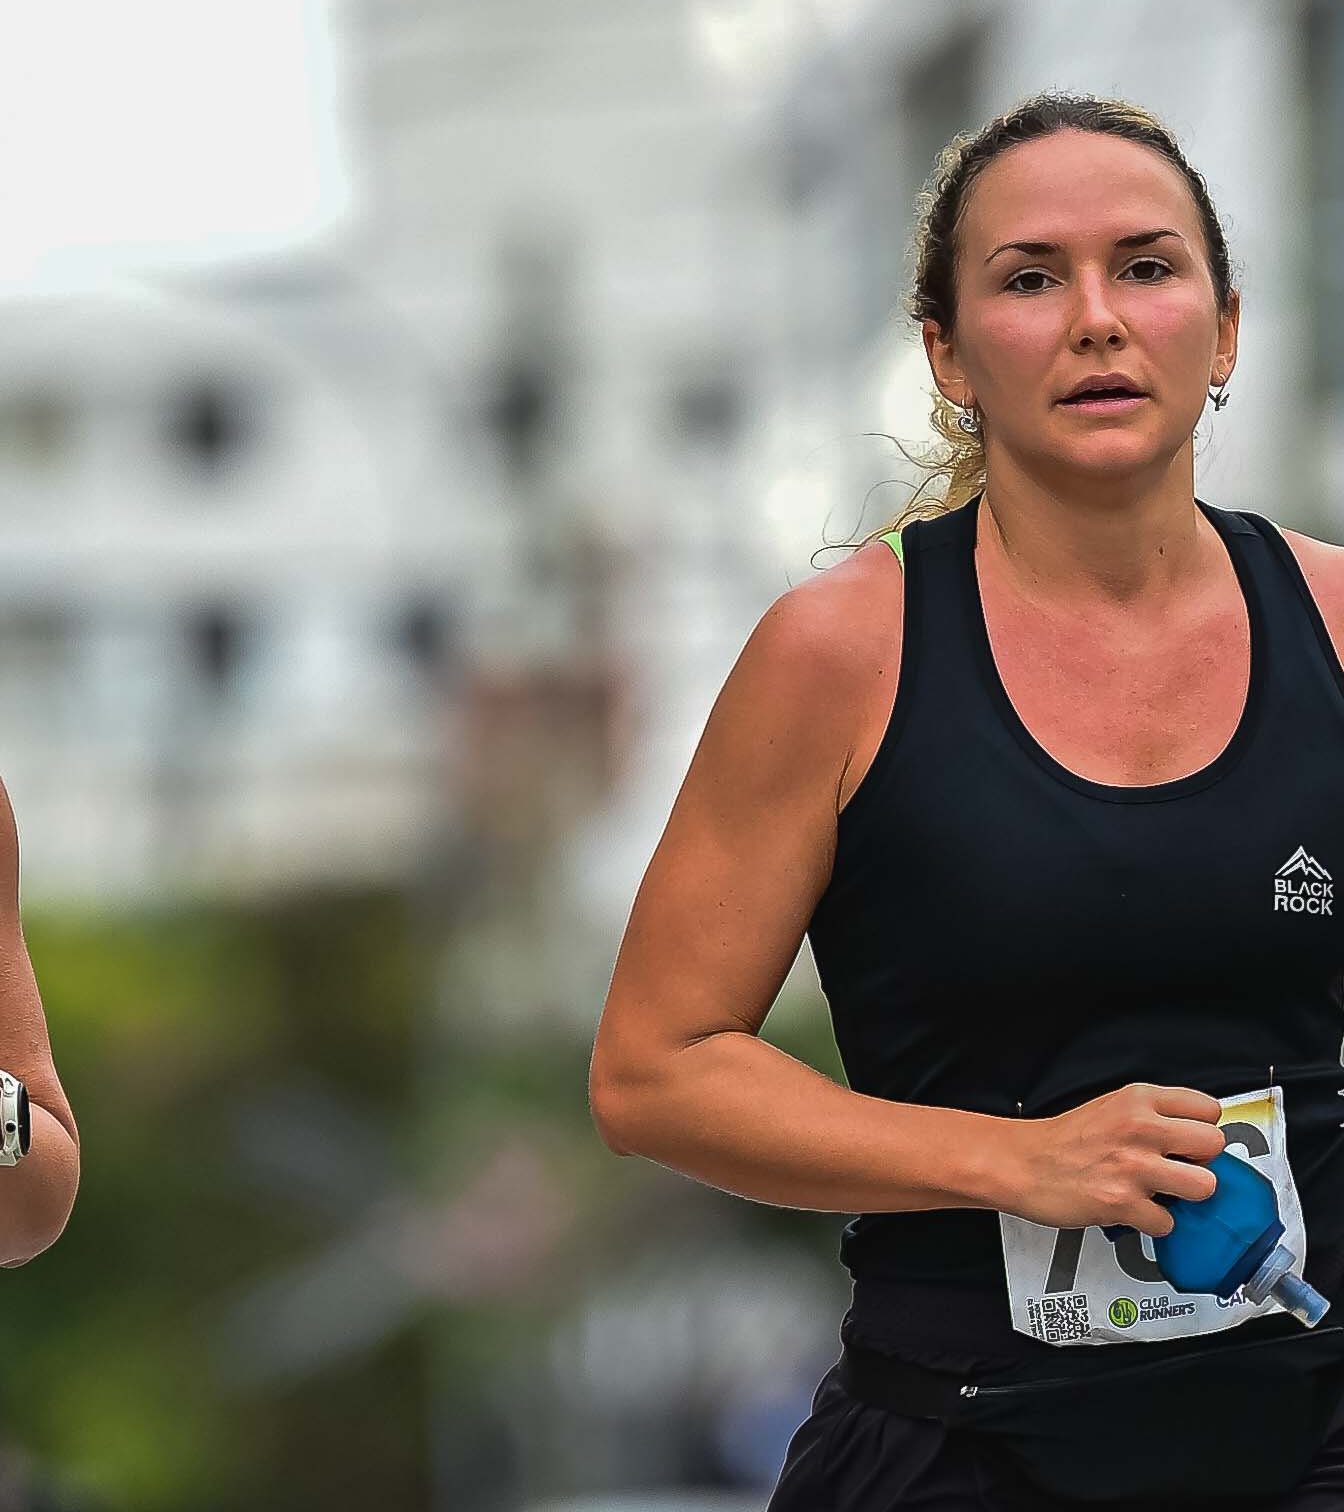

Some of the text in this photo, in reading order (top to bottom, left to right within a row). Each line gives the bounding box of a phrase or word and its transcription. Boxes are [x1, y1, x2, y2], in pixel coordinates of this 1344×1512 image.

[1274, 879, 1334, 898] BLACK
[1274, 894, 1333, 916] ROCK
[1139, 1296, 1169, 1310] CLUB
